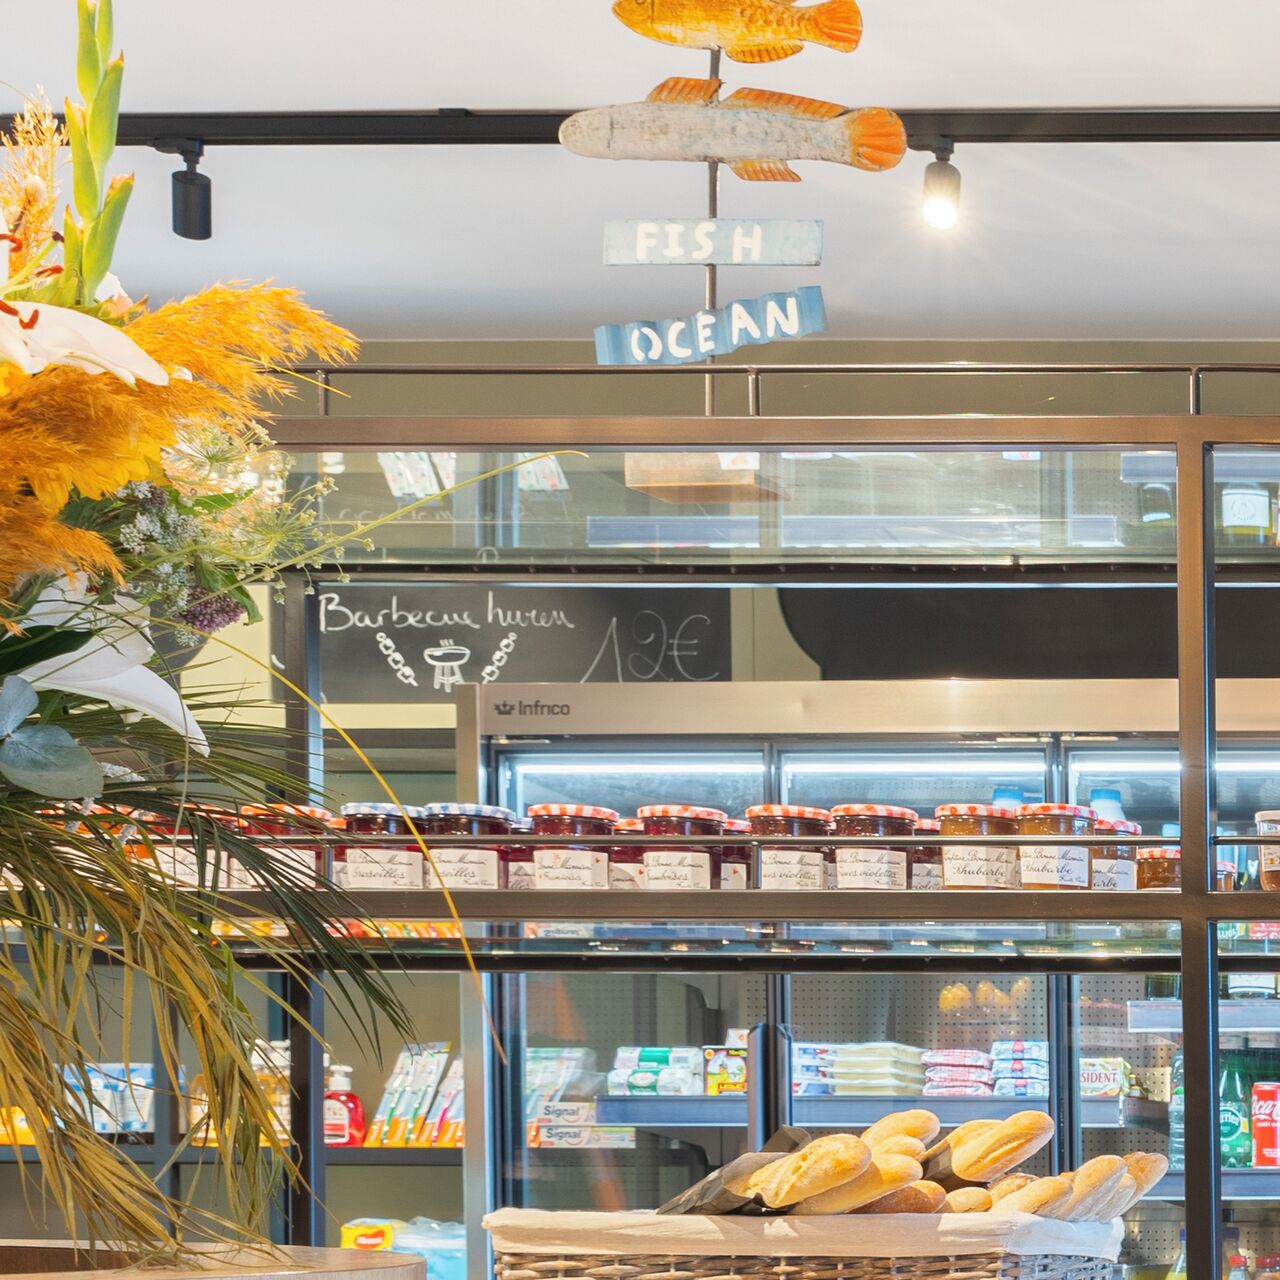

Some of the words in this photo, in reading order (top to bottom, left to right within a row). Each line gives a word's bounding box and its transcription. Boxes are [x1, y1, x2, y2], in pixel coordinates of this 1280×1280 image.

[635, 221, 764, 262] FISH
[630, 296, 800, 361] OCEAN
[319, 592, 480, 633] Barbecue
[518, 701, 570, 716] Infrico
[953, 864, 1006, 878] Rhubarbe
[1023, 862, 1073, 875] Rhubarbe
[1082, 1072, 1117, 1083] SIDENT
[544, 1105, 580, 1117] Signal
[546, 1128, 582, 1140] Signal
